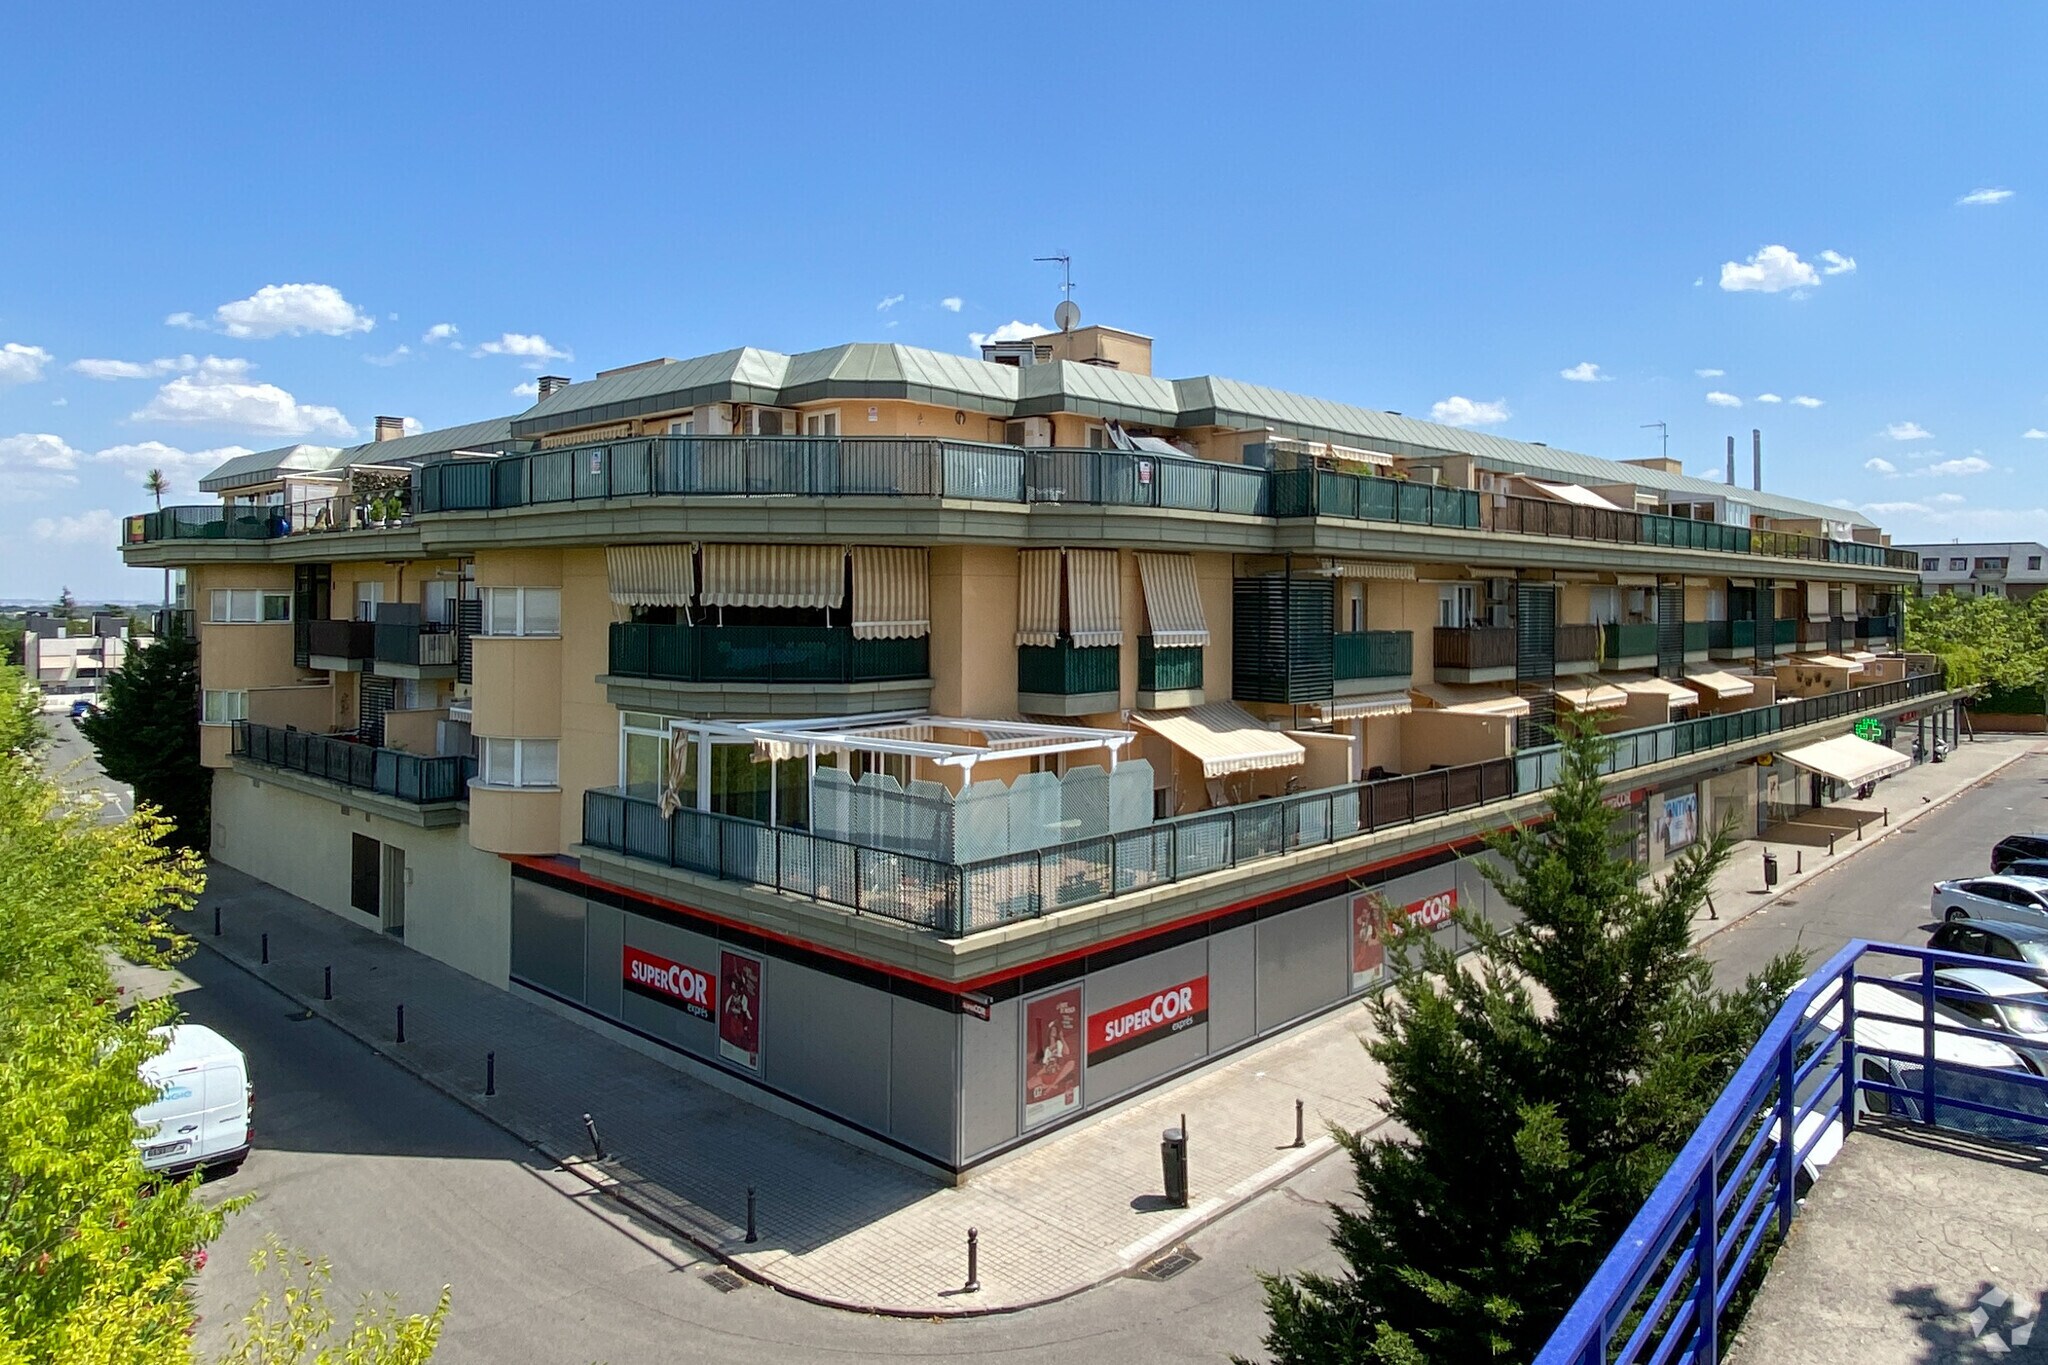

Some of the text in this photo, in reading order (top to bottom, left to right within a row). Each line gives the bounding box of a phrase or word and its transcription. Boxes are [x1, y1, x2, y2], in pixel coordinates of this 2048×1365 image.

[631, 960, 708, 1005] SUPERCOR
[1104, 986, 1193, 1042] SUPERCOR
[1171, 1015, 1194, 1031] exprés
